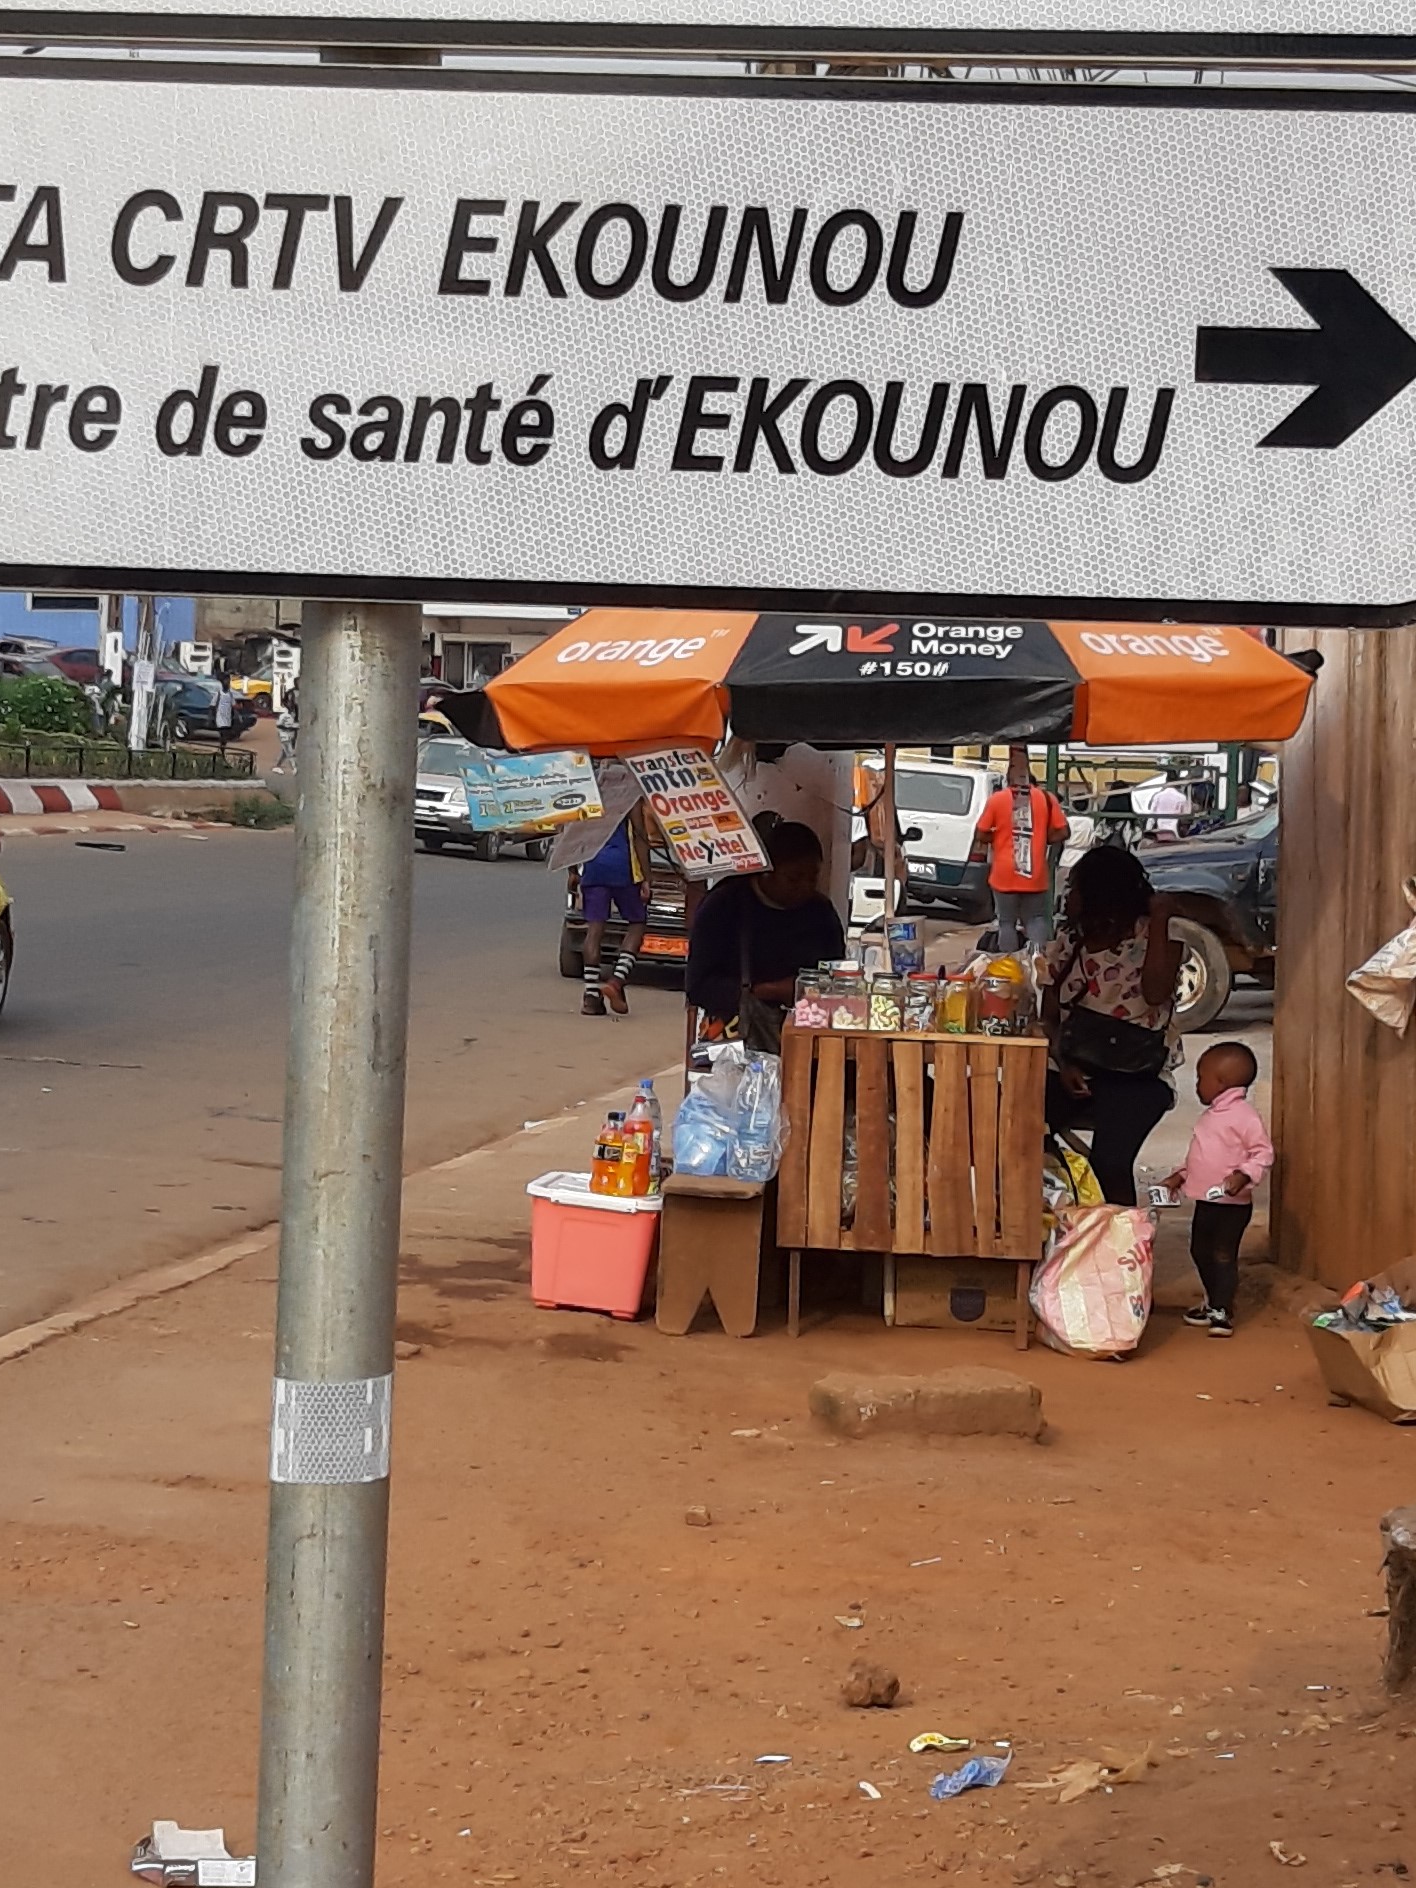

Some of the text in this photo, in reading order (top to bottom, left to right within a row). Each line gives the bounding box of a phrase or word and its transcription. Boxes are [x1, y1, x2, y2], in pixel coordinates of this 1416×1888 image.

[108, 187, 403, 294] CRTV
[437, 198, 965, 311] EKOUNOU
[154, 364, 269, 459] de
[300, 371, 556, 469] santé
[586, 373, 1176, 486] d'EKOUNOU
[911, 622, 1024, 642] Orange
[1078, 628, 1231, 664] orange
[557, 631, 706, 666] orange
[910, 639, 1014, 659] Money
[858, 661, 951, 677] #150#
[640, 768, 696, 793] mtn
[650, 789, 731, 817] Orange
